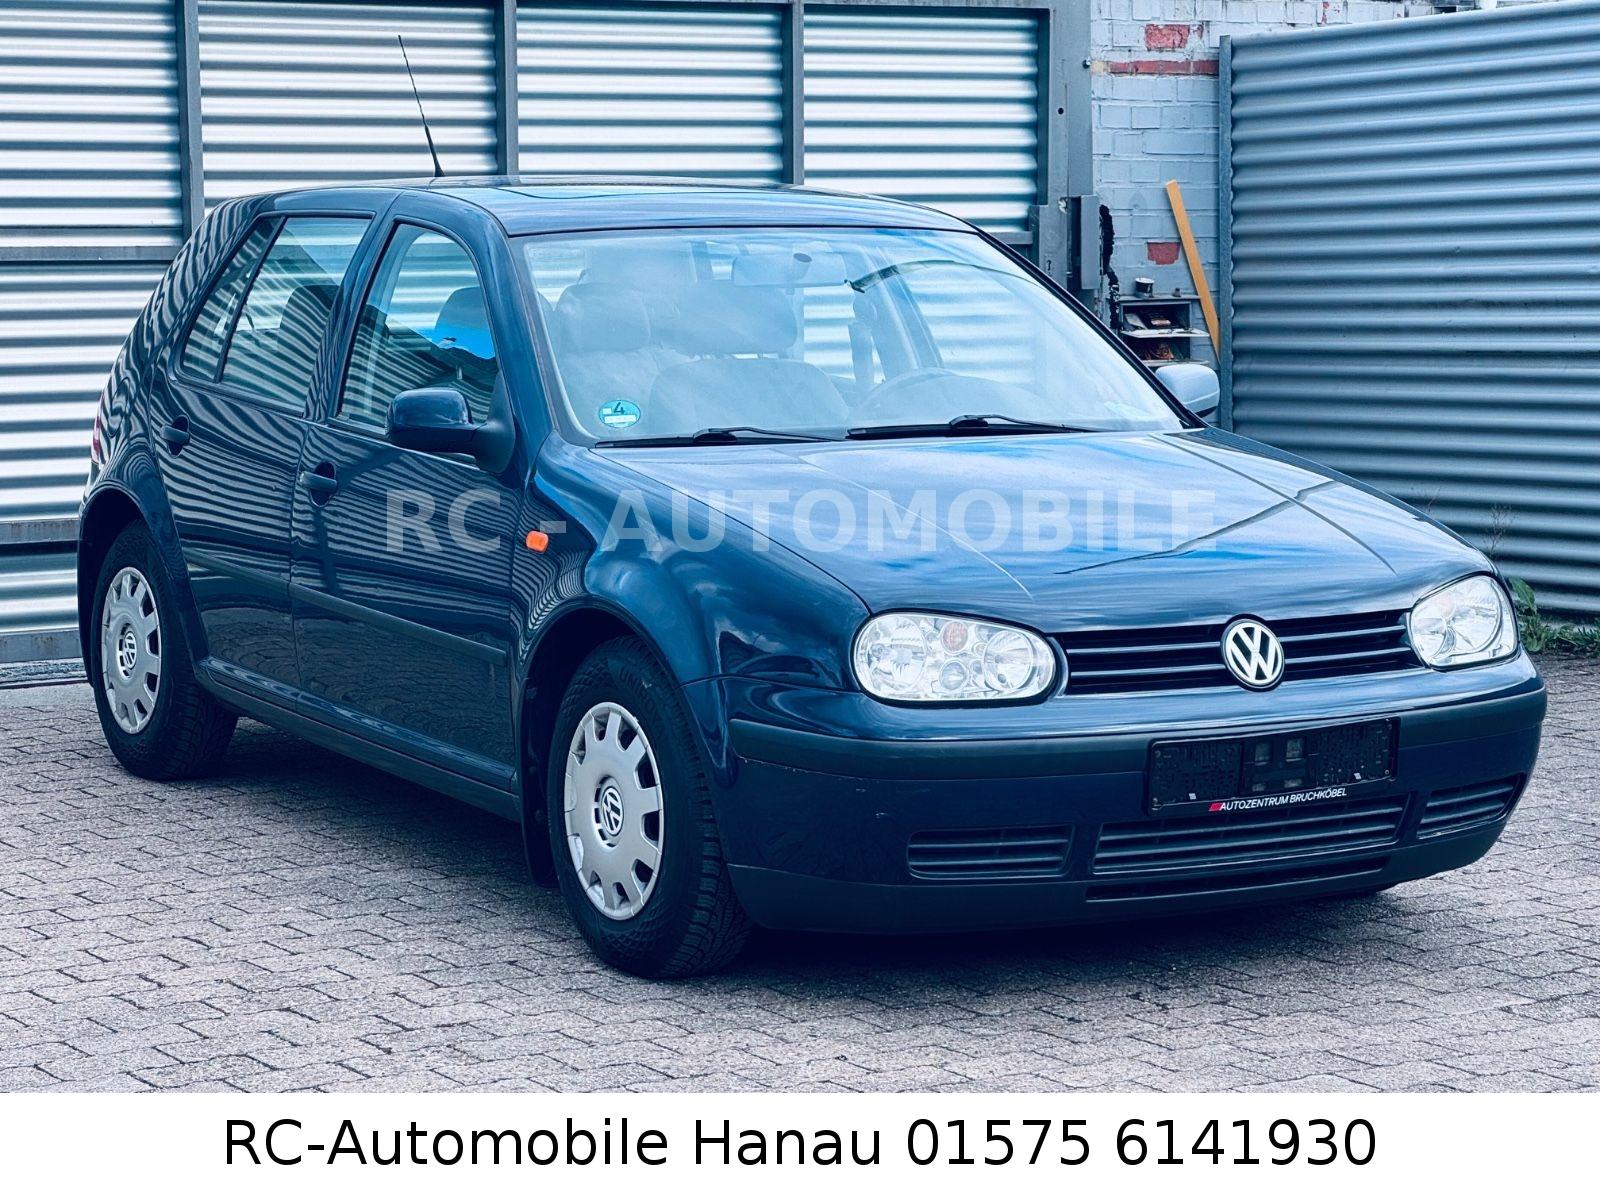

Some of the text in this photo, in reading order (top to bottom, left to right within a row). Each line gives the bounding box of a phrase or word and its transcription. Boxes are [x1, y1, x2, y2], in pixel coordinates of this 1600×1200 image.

[613, 401, 625, 414] 4
[1221, 618, 1284, 688] VW
[602, 786, 624, 836] VW
[1219, 787, 1347, 811] AUTOZENTRUM BRUCHKÖBEL
